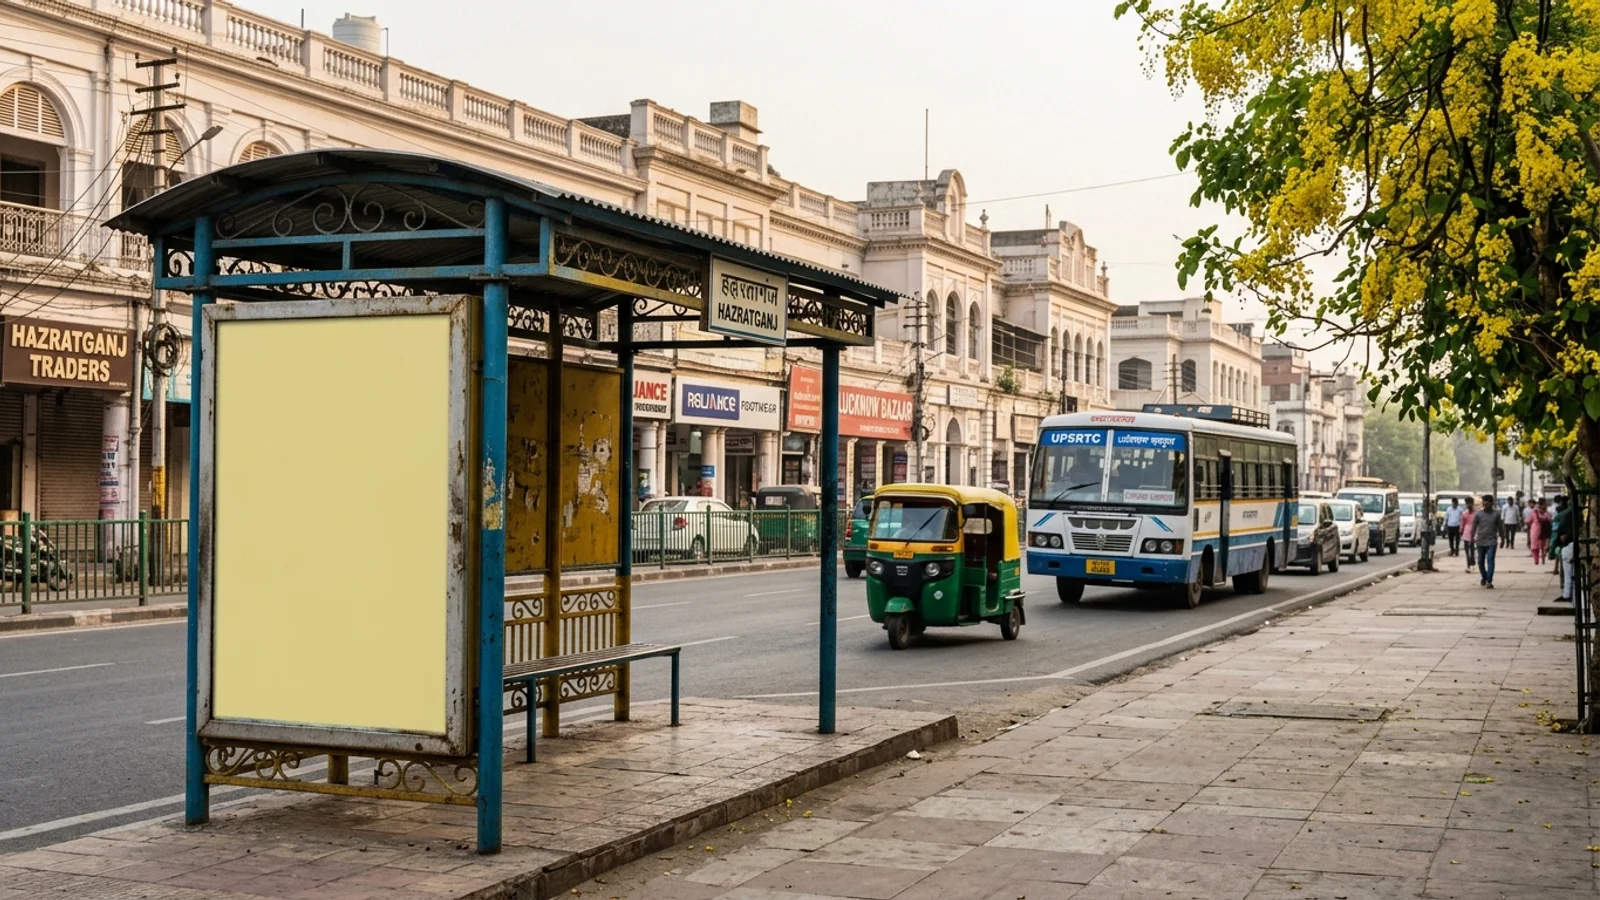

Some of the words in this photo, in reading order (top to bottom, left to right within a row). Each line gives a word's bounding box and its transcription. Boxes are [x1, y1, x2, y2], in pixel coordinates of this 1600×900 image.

[718, 302, 778, 331] HAZRATGANJ
[11, 323, 128, 358] HAZRATGANJ
[29, 353, 110, 382] TRADERS
[1051, 432, 1101, 444] UPSRTC
